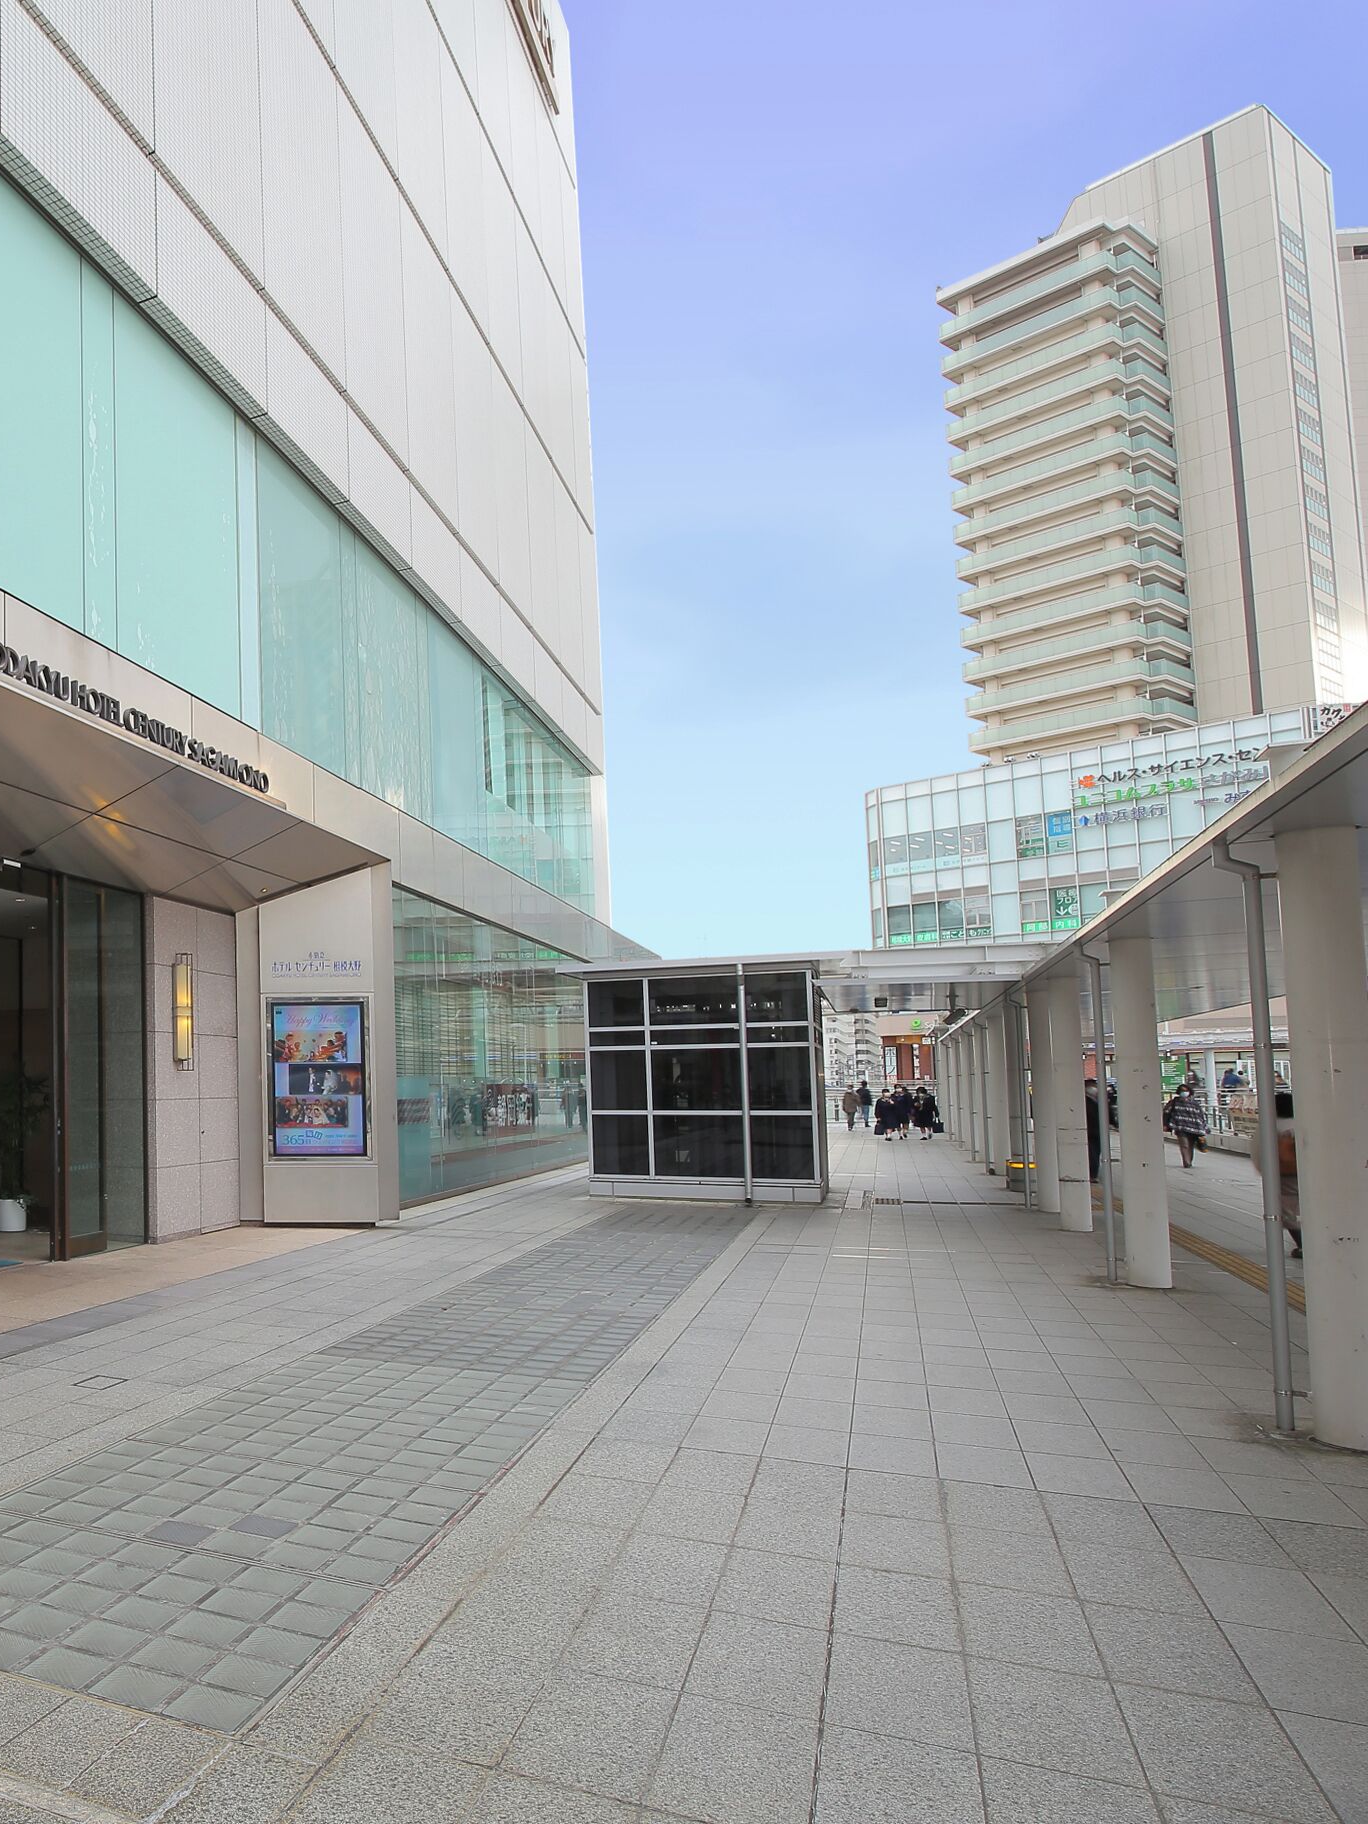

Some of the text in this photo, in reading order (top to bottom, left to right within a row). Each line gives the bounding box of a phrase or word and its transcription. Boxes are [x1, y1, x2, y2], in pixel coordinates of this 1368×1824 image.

[70, 679, 125, 728] HOTEL
[123, 707, 188, 757] CENTURY
[1094, 803, 1167, 825] 横浜銀行
